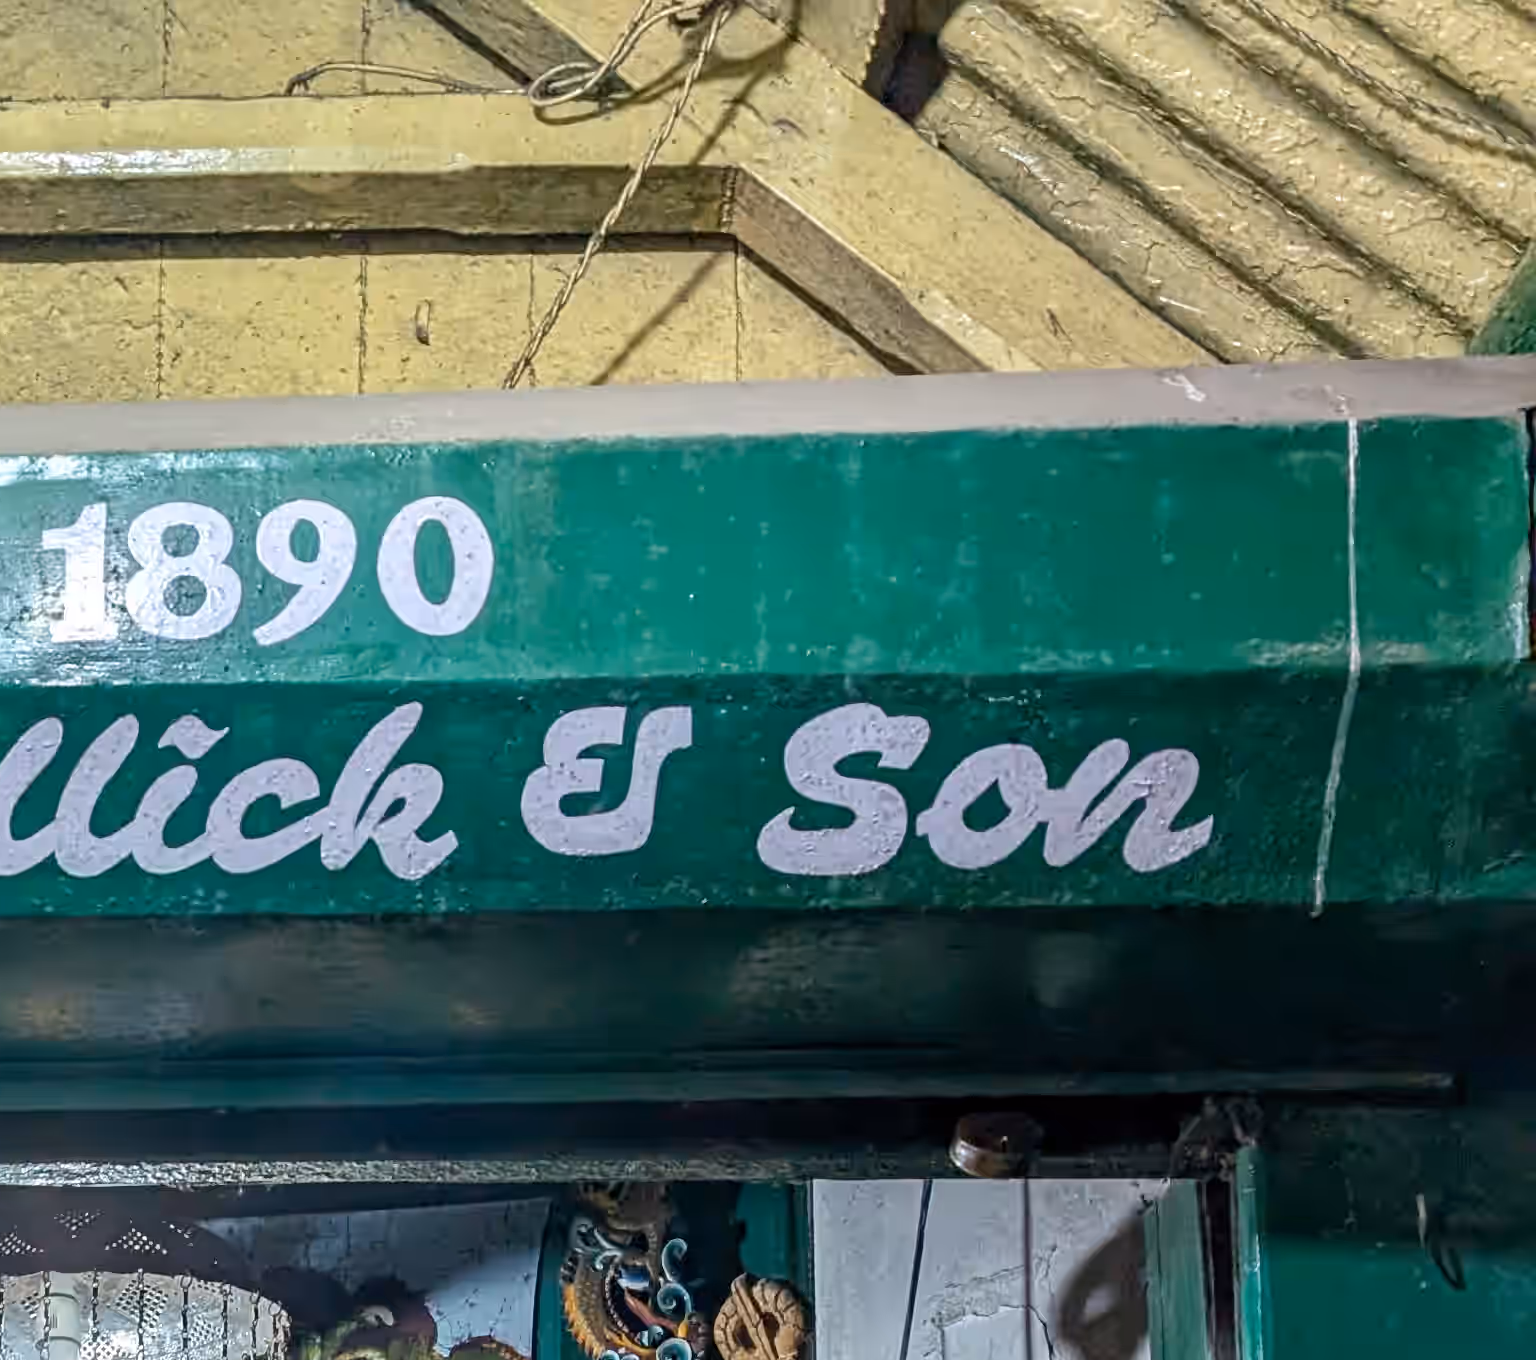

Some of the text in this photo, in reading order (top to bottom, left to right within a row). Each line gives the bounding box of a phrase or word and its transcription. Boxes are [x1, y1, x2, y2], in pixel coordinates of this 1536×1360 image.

[41, 495, 495, 646] 1890
[520, 705, 693, 857] &
[757, 703, 1214, 877] Son
